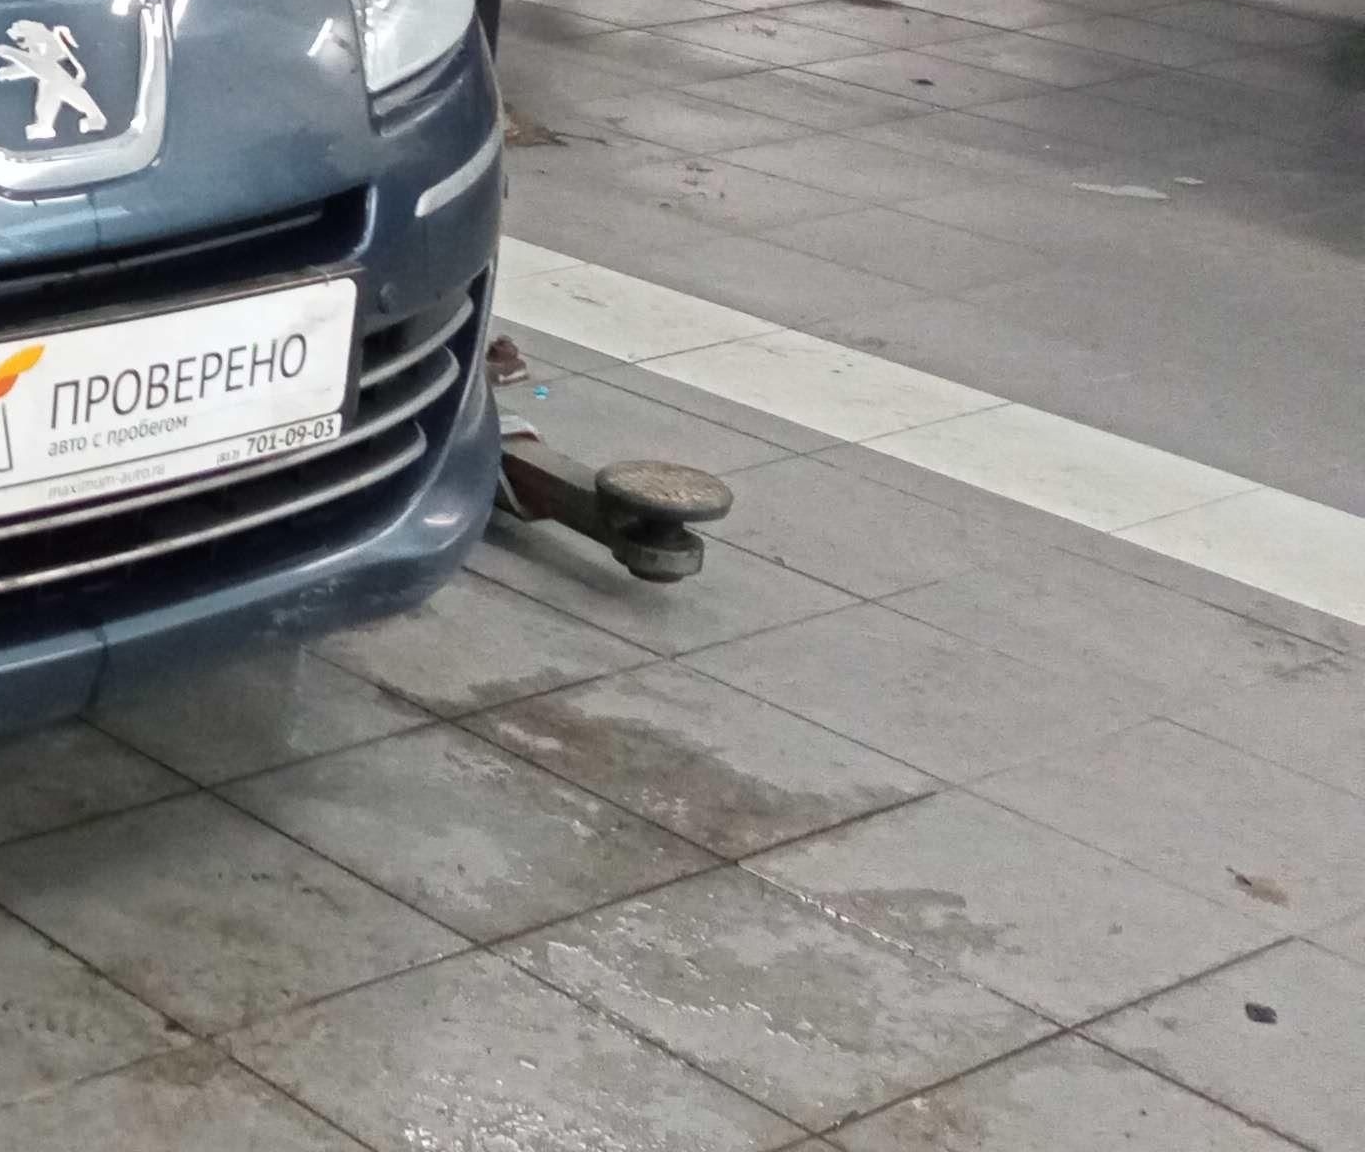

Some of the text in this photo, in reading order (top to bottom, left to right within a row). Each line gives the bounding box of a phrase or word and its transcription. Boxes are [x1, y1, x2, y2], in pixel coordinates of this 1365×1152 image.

[49, 333, 307, 430] ПРОВЕРЕНО
[48, 415, 189, 457] авто с пробегом
[246, 417, 336, 456] 701-09-03
